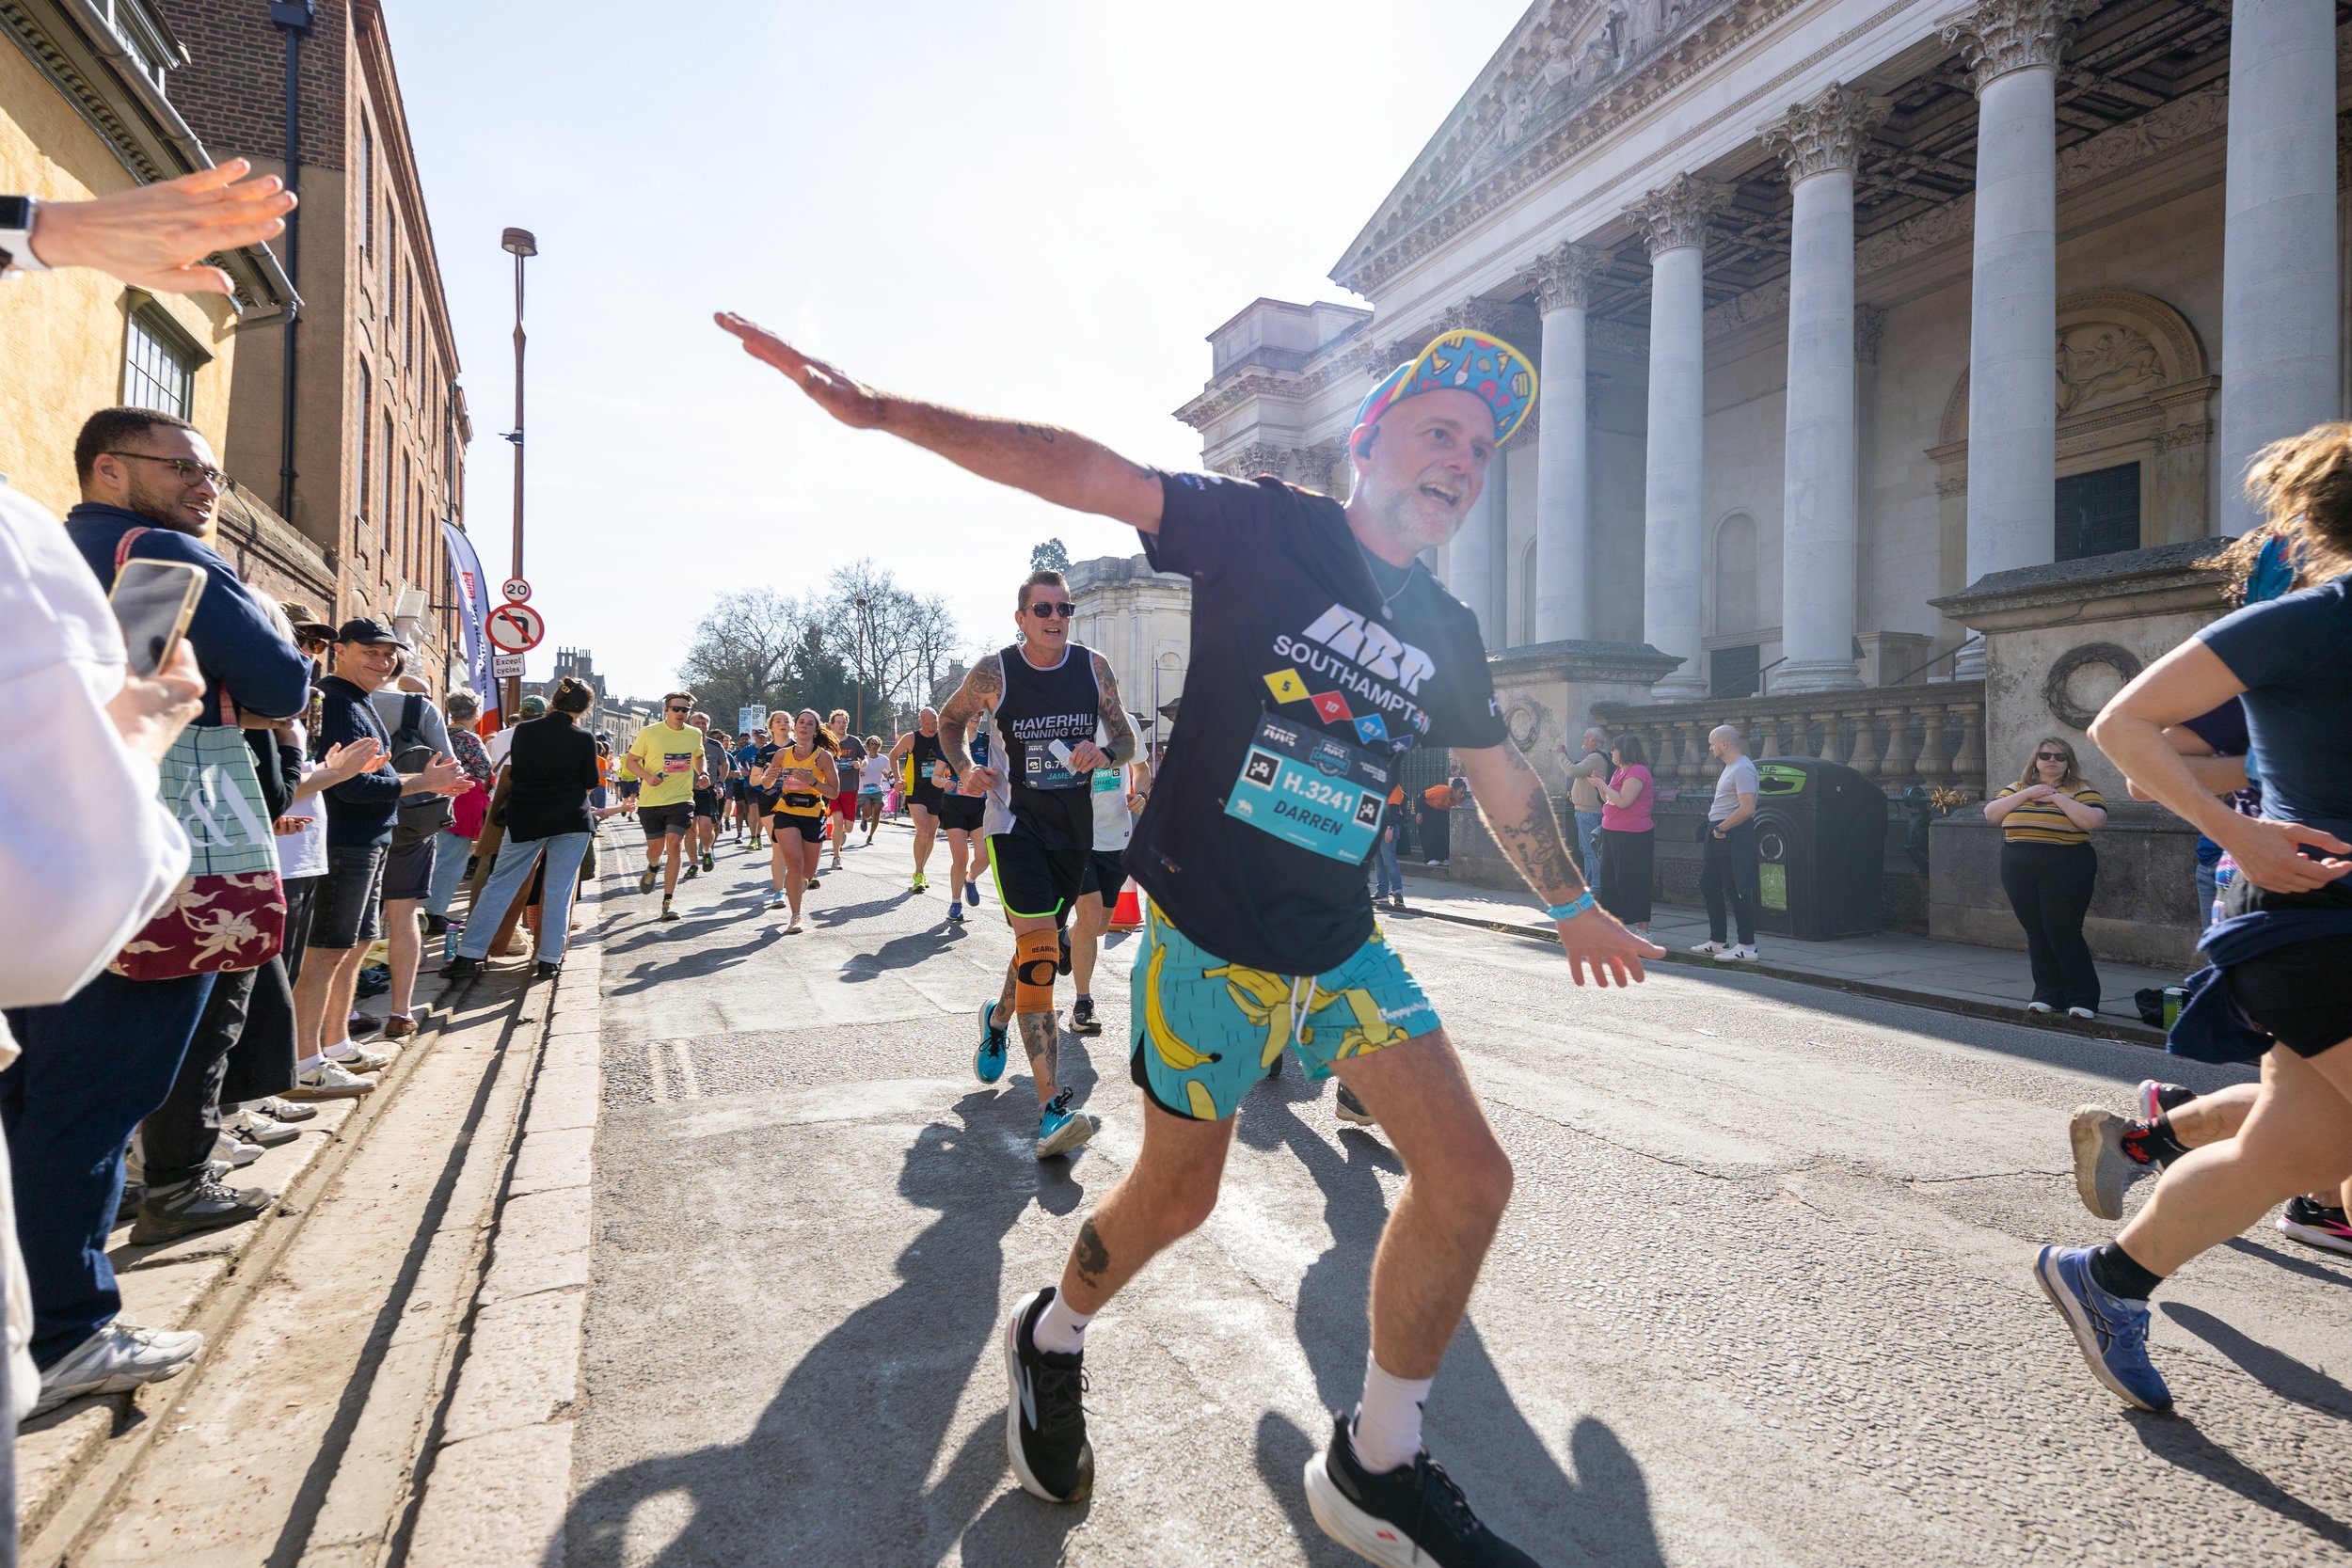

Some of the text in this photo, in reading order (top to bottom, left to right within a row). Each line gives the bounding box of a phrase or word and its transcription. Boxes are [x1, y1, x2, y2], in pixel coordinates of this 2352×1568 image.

[506, 583, 527, 594] 20
[496, 657, 522, 666] Except
[497, 666, 520, 674] cycles
[1281, 680, 1292, 692] 5
[1325, 701, 1340, 713] 10
[1012, 713, 1093, 731] HAVERHILL
[1014, 728, 1068, 740] RUNNING
[1044, 760, 1065, 769] G.7
[1046, 772, 1073, 781] JAMES
[1282, 772, 1354, 813] H.3241
[1273, 800, 1343, 836] DARREN
